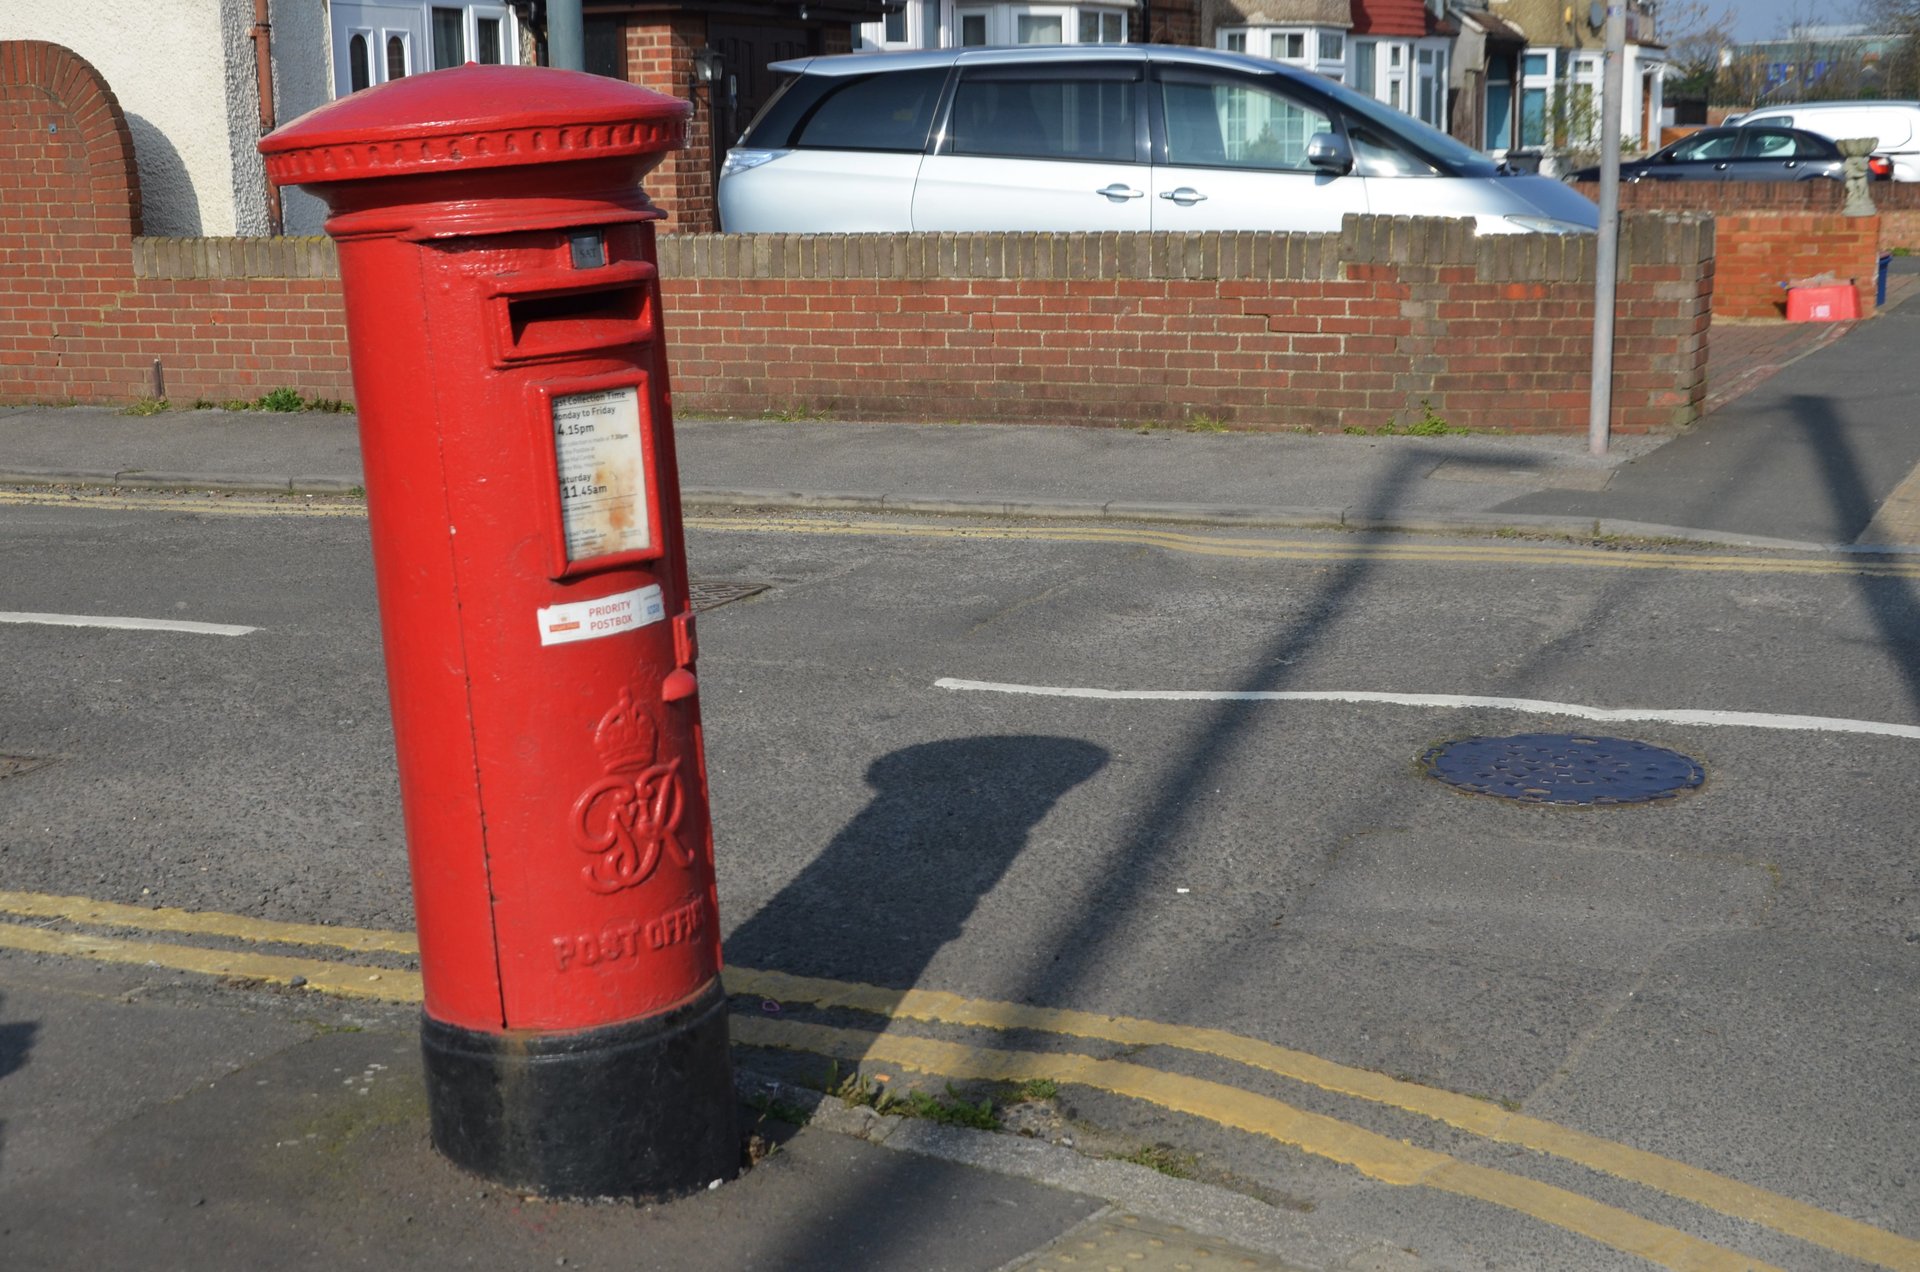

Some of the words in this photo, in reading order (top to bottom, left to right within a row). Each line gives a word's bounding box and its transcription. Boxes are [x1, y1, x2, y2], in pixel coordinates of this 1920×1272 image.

[553, 397, 567, 407] ast
[568, 393, 606, 405] Collection
[607, 391, 626, 400] Time
[592, 406, 616, 416] Friday
[557, 423, 595, 436] 4.15pm
[562, 485, 607, 499] 11.45am
[588, 600, 632, 617] PRIORITY
[590, 614, 633, 631] POSTBOX
[552, 919, 640, 972] POST
